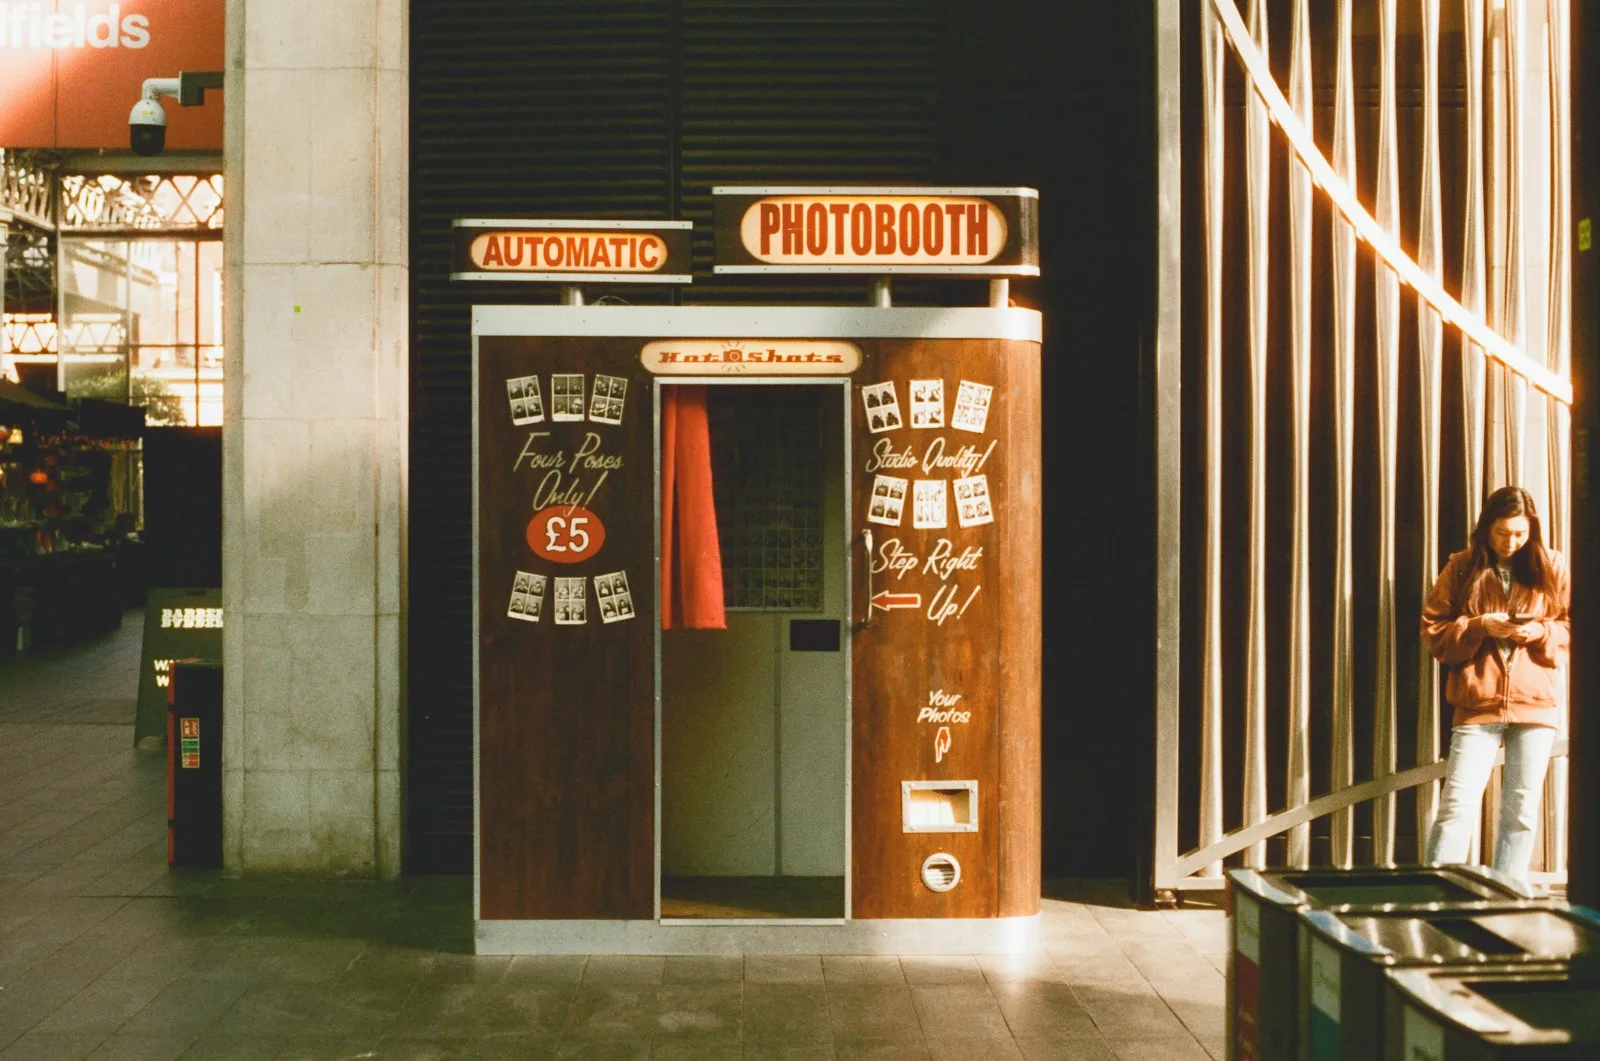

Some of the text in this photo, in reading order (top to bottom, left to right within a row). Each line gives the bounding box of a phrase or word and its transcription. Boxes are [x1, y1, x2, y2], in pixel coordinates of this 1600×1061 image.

[760, 203, 988, 256] PHOTOBOOTH
[482, 235, 659, 268] AUTOMATIC
[658, 349, 844, 363] Hot Shots
[513, 431, 624, 474] Four Poses
[866, 436, 998, 478] Studio Quality!
[532, 469, 609, 517] Only!
[545, 516, 590, 552] £5
[871, 538, 984, 580] Step Right
[927, 584, 982, 626] Up!
[916, 707, 972, 724] Photos
[928, 688, 962, 707] Your
